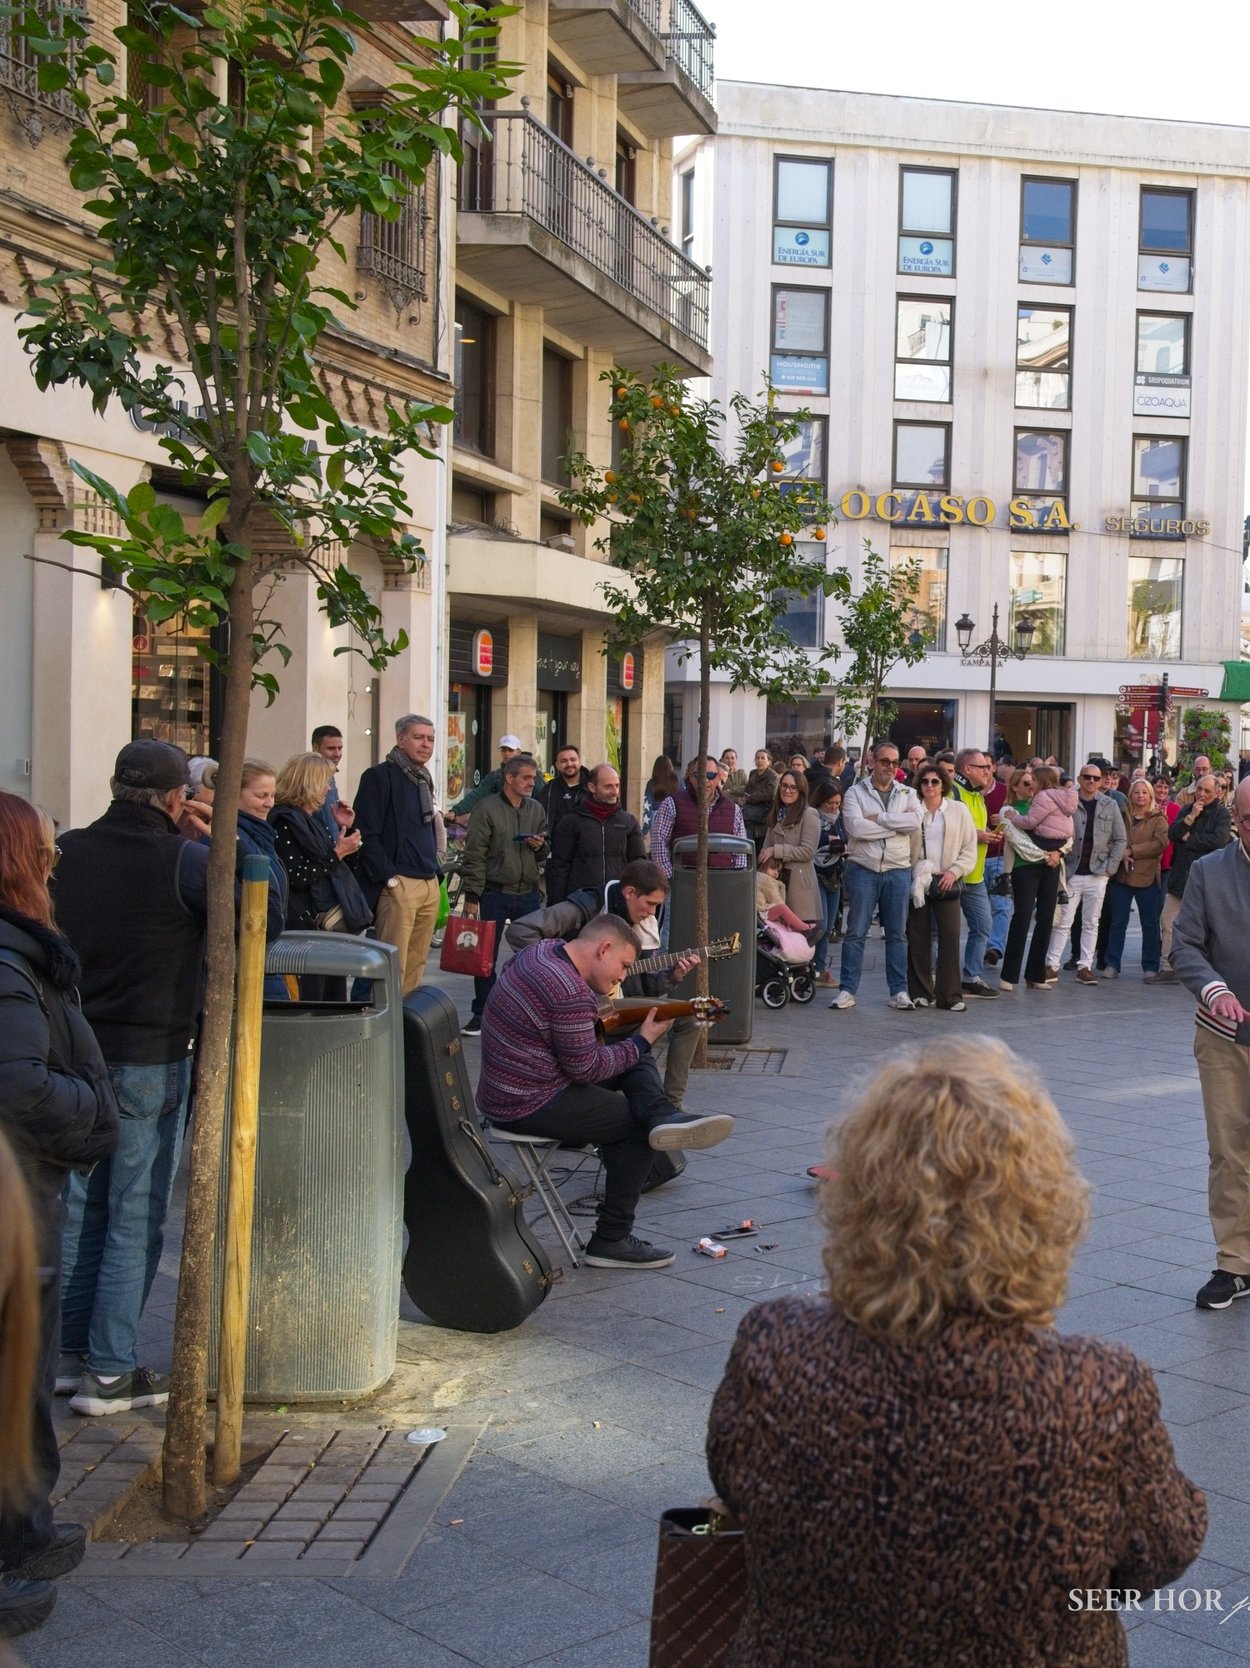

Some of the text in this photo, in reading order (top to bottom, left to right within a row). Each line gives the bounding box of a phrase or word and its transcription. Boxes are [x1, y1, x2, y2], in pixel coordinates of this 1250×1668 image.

[789, 256, 818, 264] EUROPA
[914, 265, 942, 274] EUROPA
[1136, 395, 1188, 408] OZOAQUA
[840, 489, 1211, 536] OCASO S.A. SEGUROS
[960, 659, 1003, 668] CAMPAA
